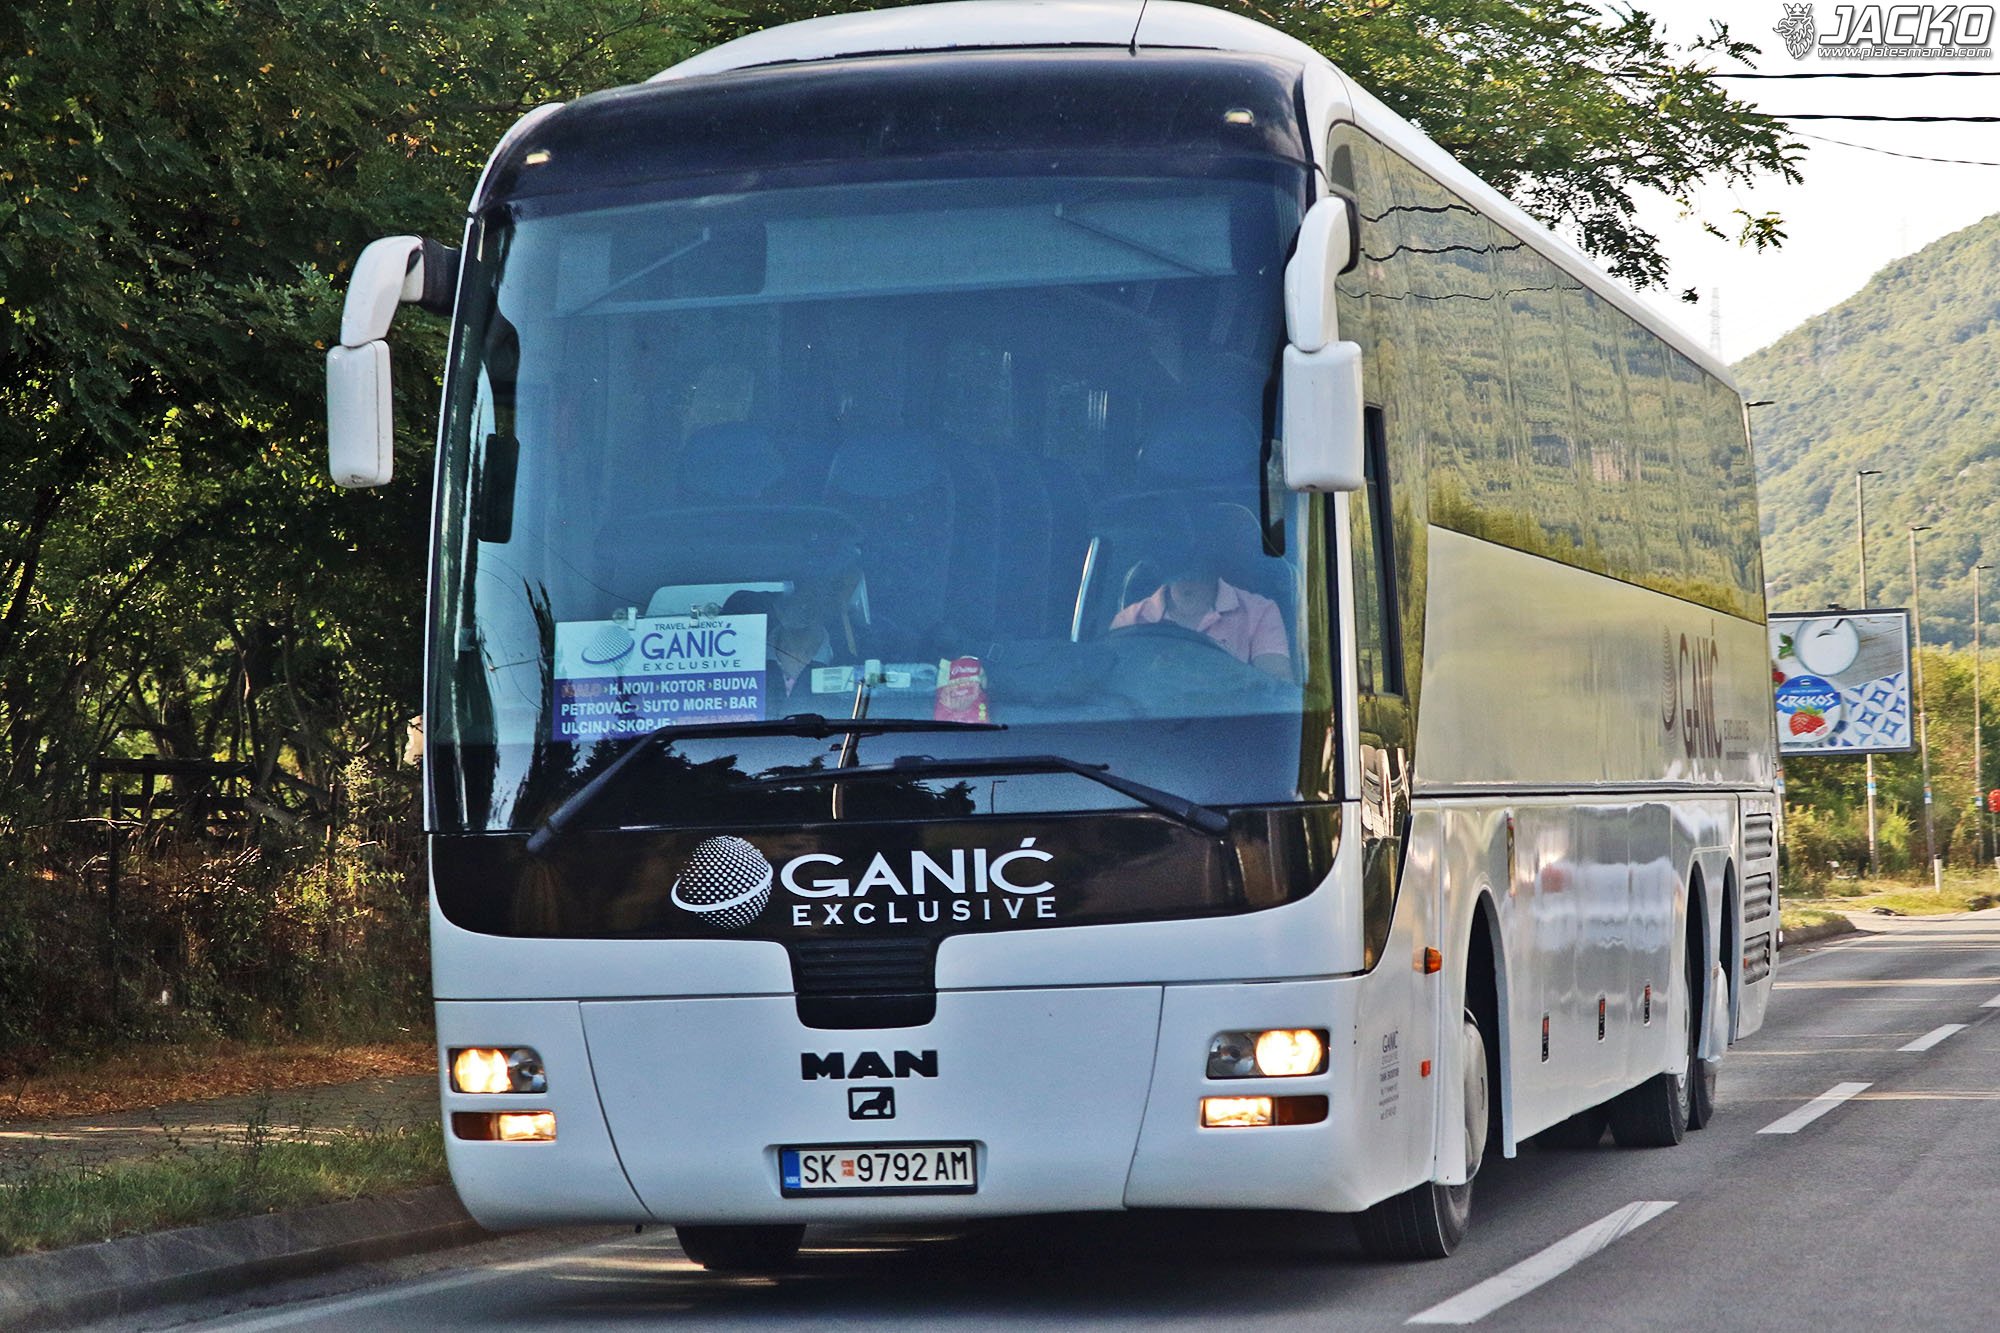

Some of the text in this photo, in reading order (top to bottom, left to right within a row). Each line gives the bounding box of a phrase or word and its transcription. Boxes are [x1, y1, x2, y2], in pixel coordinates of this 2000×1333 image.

[655, 620, 723, 631] TRAVEL ENCY
[641, 623, 737, 660] GANIĆ
[643, 659, 741, 672] EXCLUSIVE
[660, 679, 706, 694] KOTOR
[712, 676, 758, 691] BUDVA
[561, 701, 632, 716] PETROVAC
[683, 697, 722, 712] MORE
[729, 695, 758, 709] BAR
[561, 721, 610, 735] ULCINJ
[780, 836, 1055, 898] GANIĆ
[792, 896, 1057, 927] EXCLUSIVE
[800, 1049, 938, 1080] MAN
[803, 1154, 837, 1183] SK
[856, 1153, 928, 1182] 9792
[934, 1151, 969, 1181] AM
